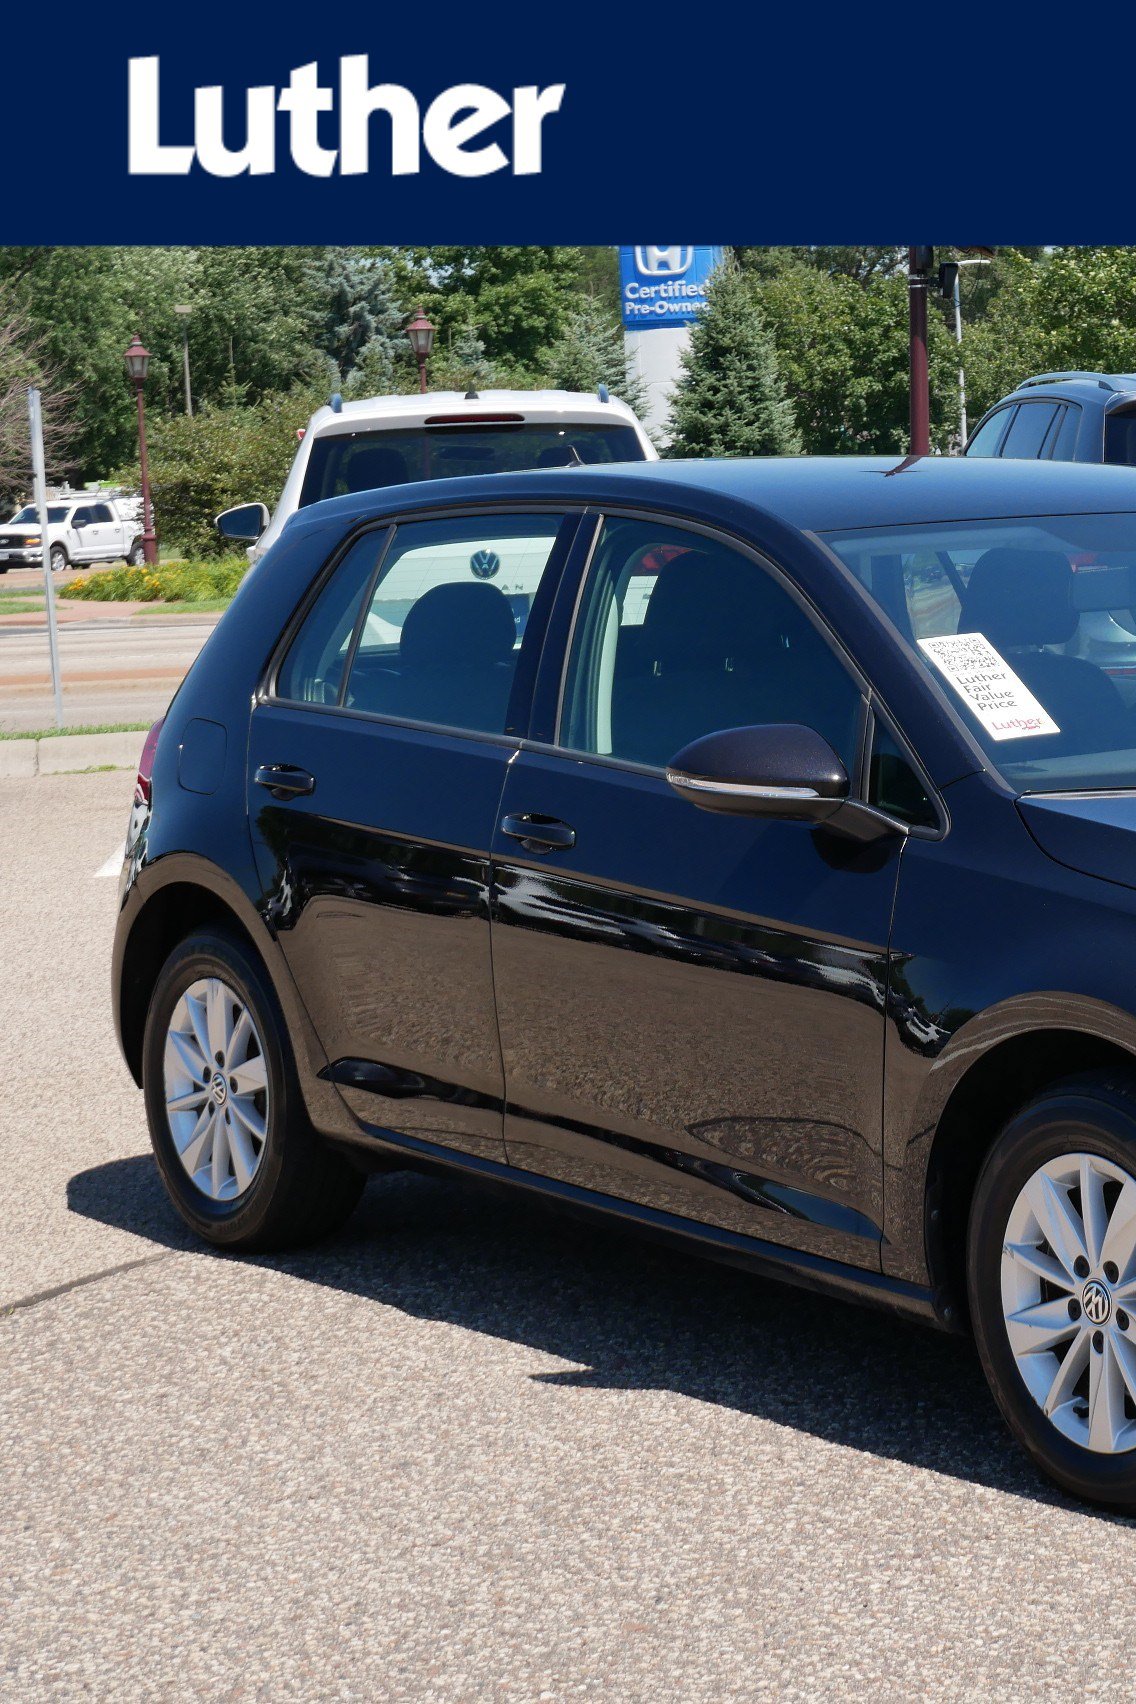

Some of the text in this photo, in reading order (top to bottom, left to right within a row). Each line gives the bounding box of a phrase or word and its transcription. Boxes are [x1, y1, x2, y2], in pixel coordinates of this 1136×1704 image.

[957, 673, 1006, 685] Luther
[962, 683, 992, 694] Fair
[970, 691, 1014, 701] Value
[977, 700, 1018, 711] Price
[991, 717, 1043, 731] Luther
